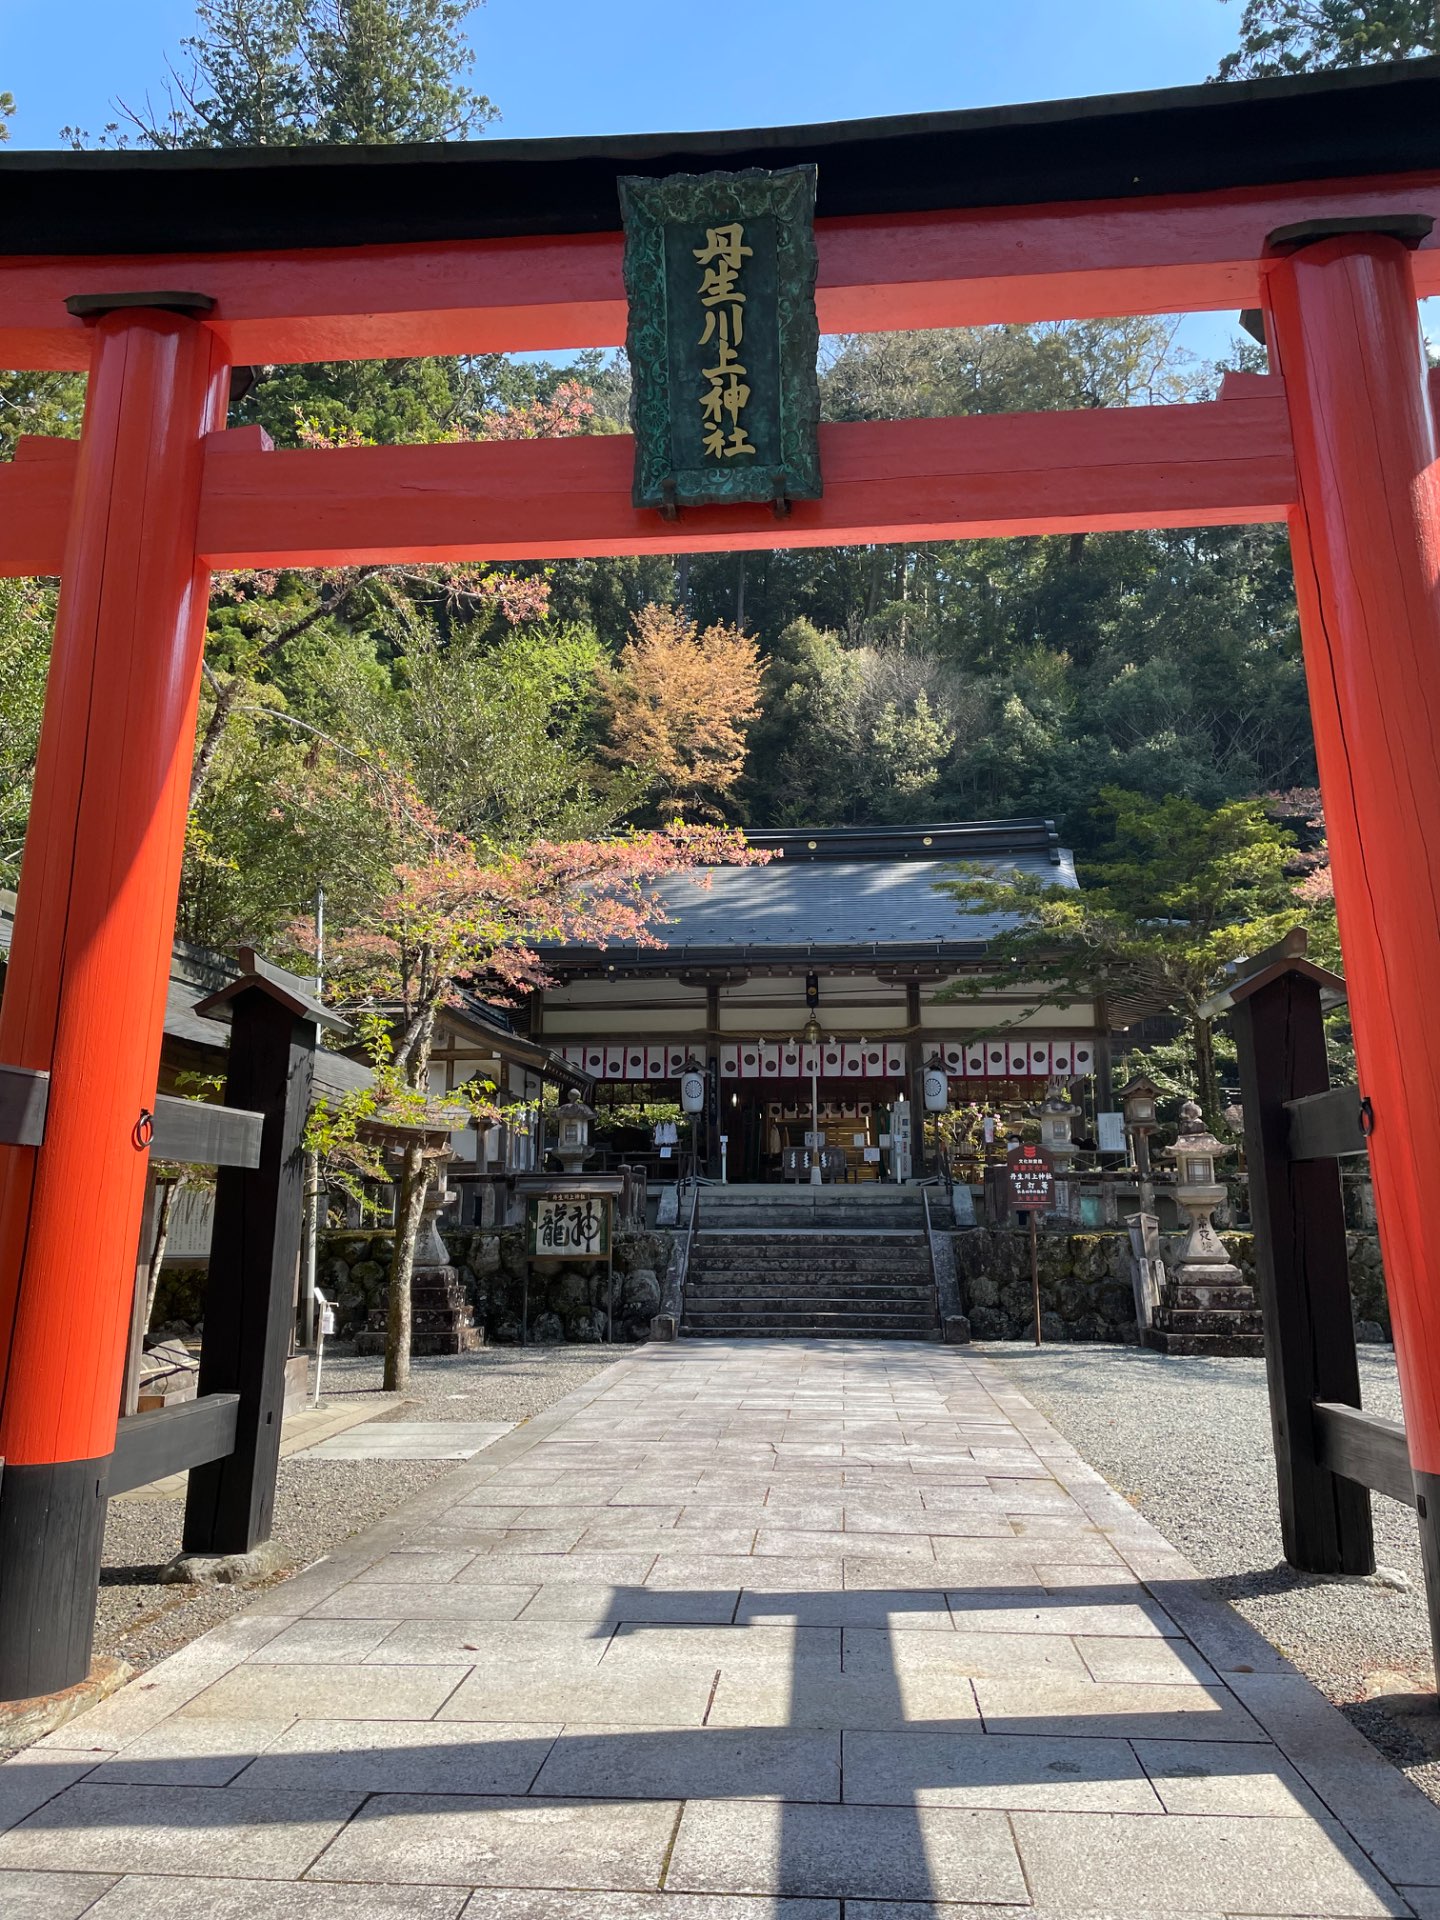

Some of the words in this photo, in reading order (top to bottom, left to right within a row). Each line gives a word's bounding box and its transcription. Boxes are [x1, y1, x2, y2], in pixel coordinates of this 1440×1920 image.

[693, 223, 756, 459] 丹生川上神社
